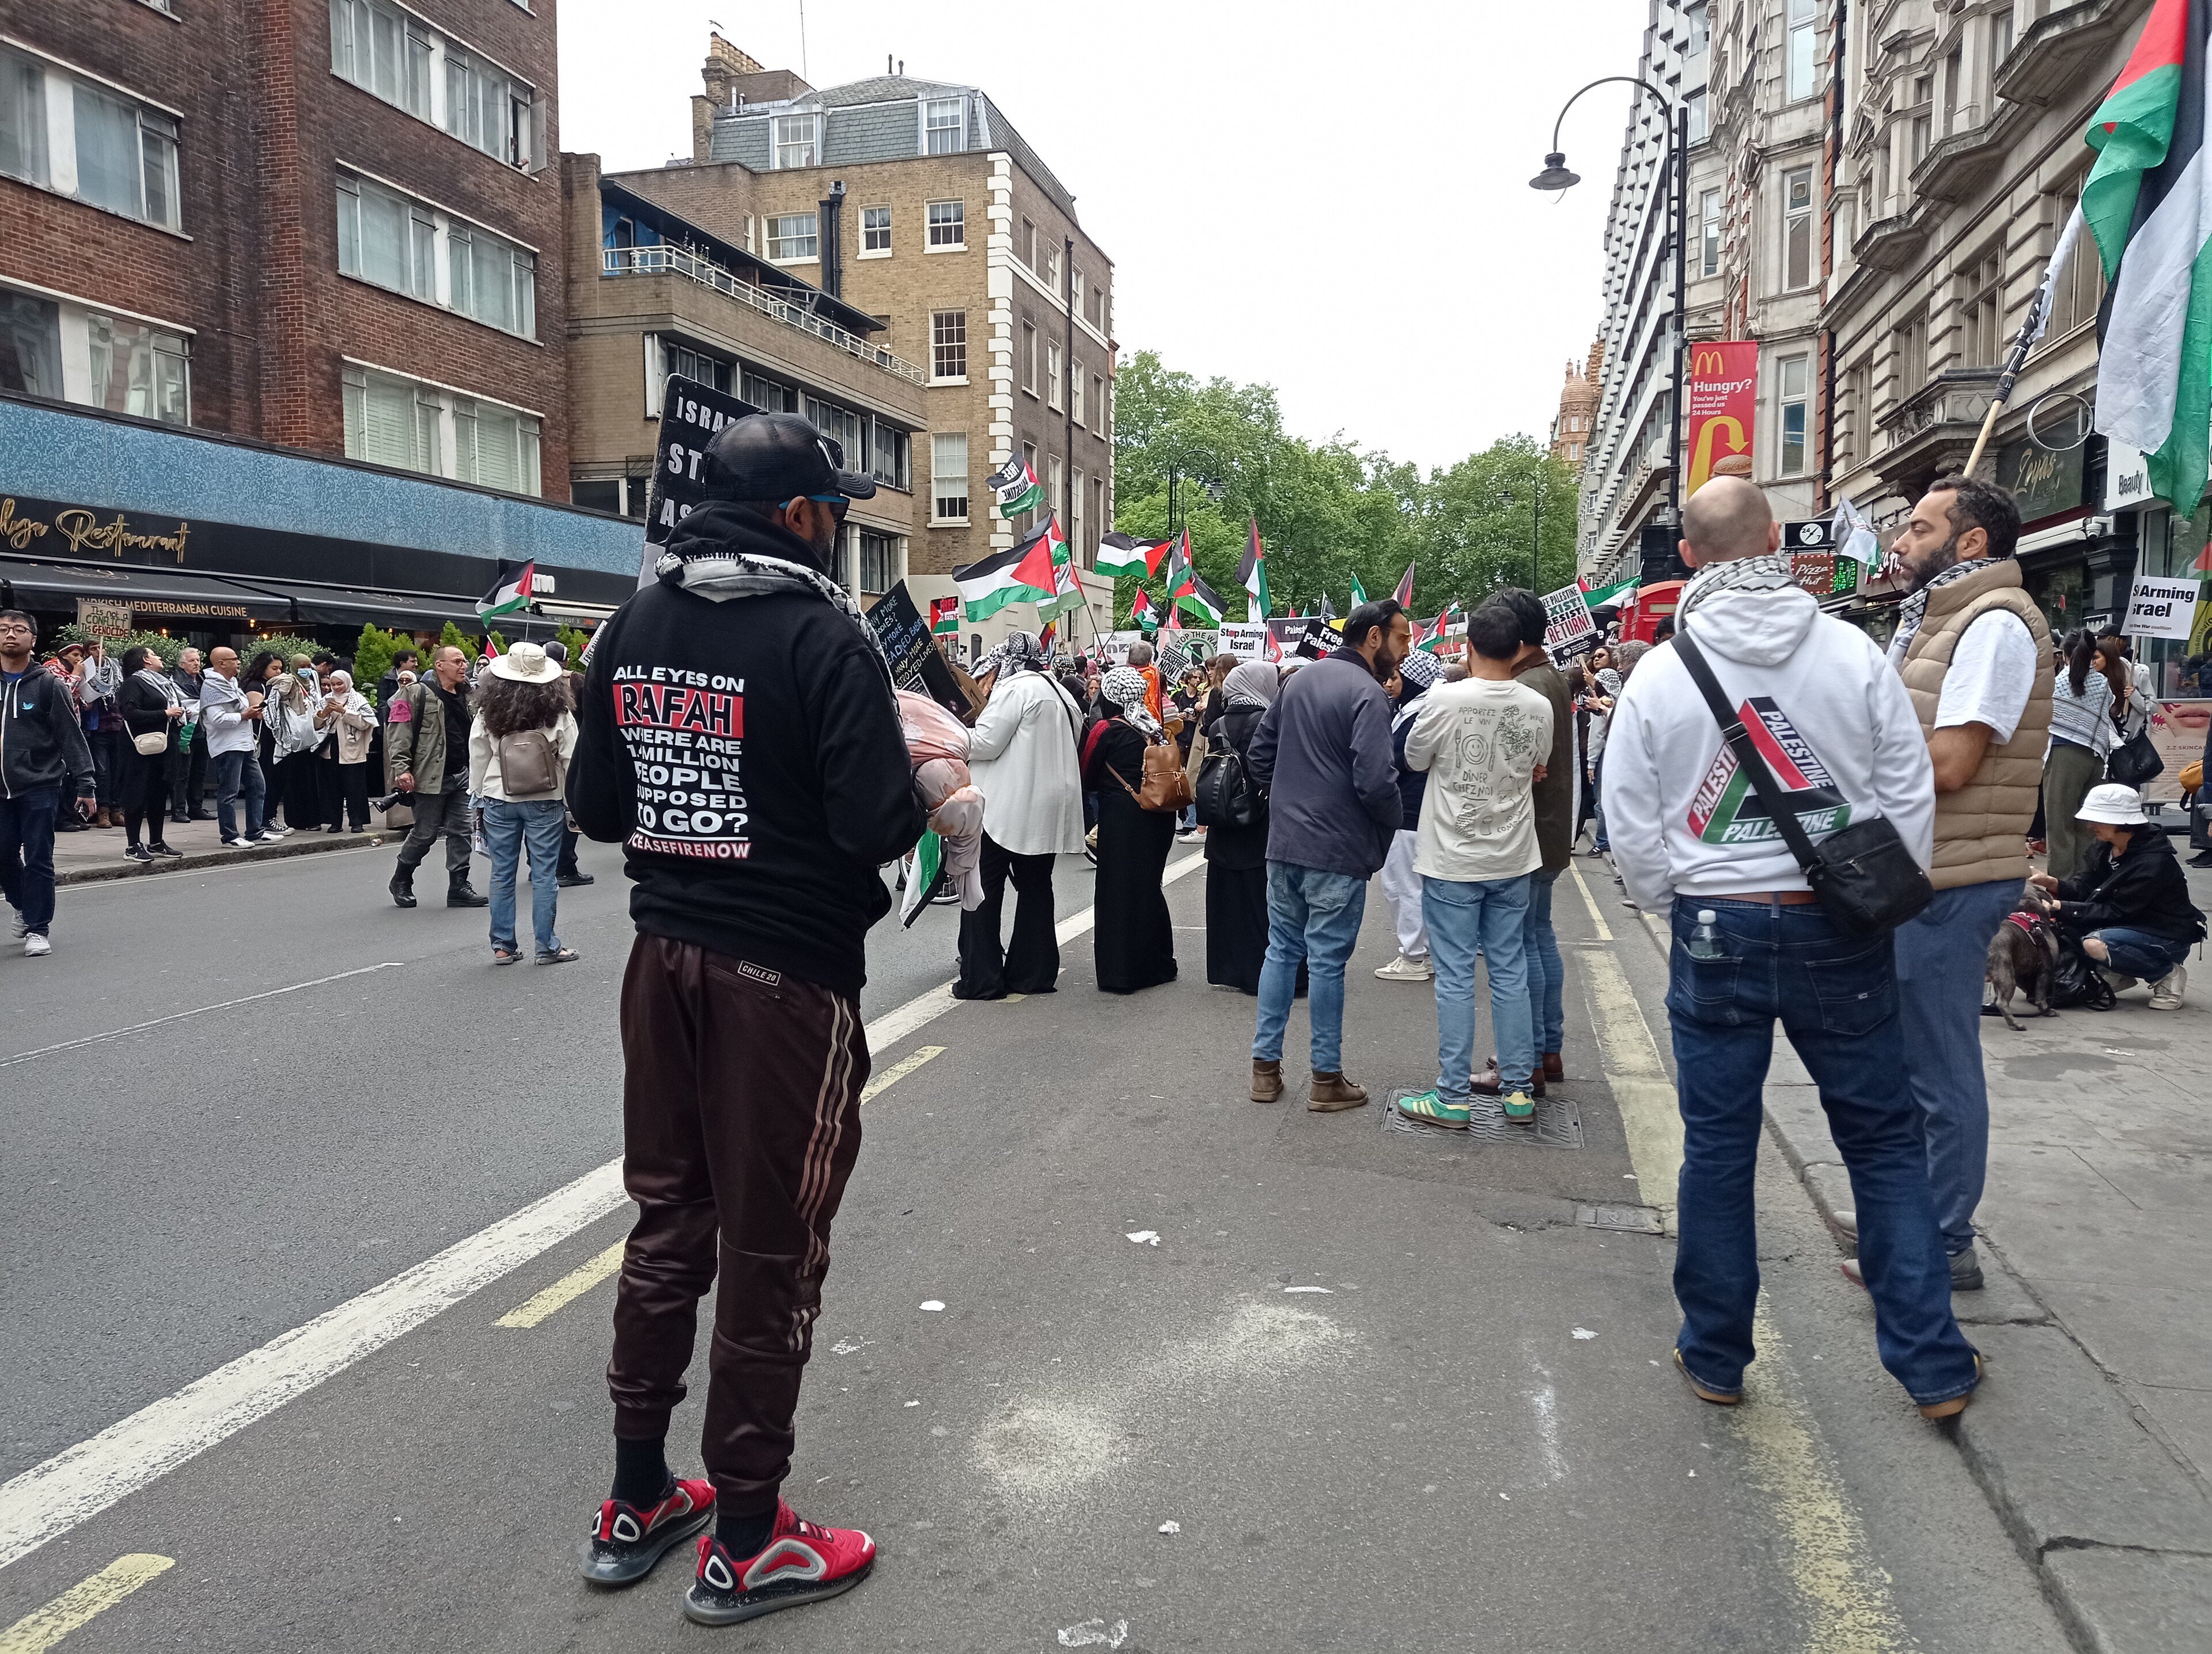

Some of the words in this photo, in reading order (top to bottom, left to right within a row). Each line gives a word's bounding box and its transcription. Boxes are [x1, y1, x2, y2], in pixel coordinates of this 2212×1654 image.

[1694, 378, 1752, 394] Hungry?
[1692, 401, 1716, 410] passed
[1714, 394, 1728, 403] just
[668, 443, 705, 483] ST
[2119, 470, 2143, 495] Beauty
[56, 509, 191, 563] Restaurant
[1796, 564, 1829, 576] Pizza
[1799, 575, 1825, 586] Hut
[1550, 586, 1579, 605] PALESTINE
[2139, 585, 2195, 603] Arming
[106, 610, 119, 619] not
[126, 600, 209, 615] MEDITERRANEAN
[211, 605, 248, 617] CUISINE
[880, 595, 899, 617] MORE
[86, 614, 127, 629] CONFLICT
[1547, 605, 1586, 627] RESIST!
[92, 625, 128, 638] GENOCIDE
[887, 623, 904, 644] MORE
[1220, 628, 1239, 639] Stp
[1240, 629, 1264, 640] Arming
[1320, 627, 1343, 646] Free
[1547, 613, 1592, 644] RETURN!
[1175, 633, 1190, 650] STOP
[1191, 631, 1207, 639] THE
[1230, 639, 1255, 651] Israel
[895, 657, 910, 676] MANY
[908, 638, 924, 659] MORE
[921, 639, 937, 663] LIVES?
[1158, 661, 1181, 680] NOW!
[1160, 651, 1187, 671] CEASEFIRE
[612, 665, 647, 681] ALL
[651, 667, 709, 687] EYES
[711, 675, 745, 693] ON
[620, 684, 733, 736] RAFAH
[1458, 706, 1496, 716] APPORTEZ
[1464, 717, 1474, 725] LE
[1479, 717, 1491, 725] VIN
[695, 735, 742, 756] ARE
[1759, 711, 1835, 789] PALESTINE
[642, 745, 740, 772] MILLION
[634, 761, 744, 792] PEOPLE
[1453, 782, 1477, 795] CHEZ
[1478, 786, 1493, 797] MOI
[637, 801, 657, 829] TO
[662, 808, 748, 834] GO?
[1720, 809, 1838, 842] PALETINE
[742, 965, 767, 979] CHILE
[766, 973, 777, 982] 20
